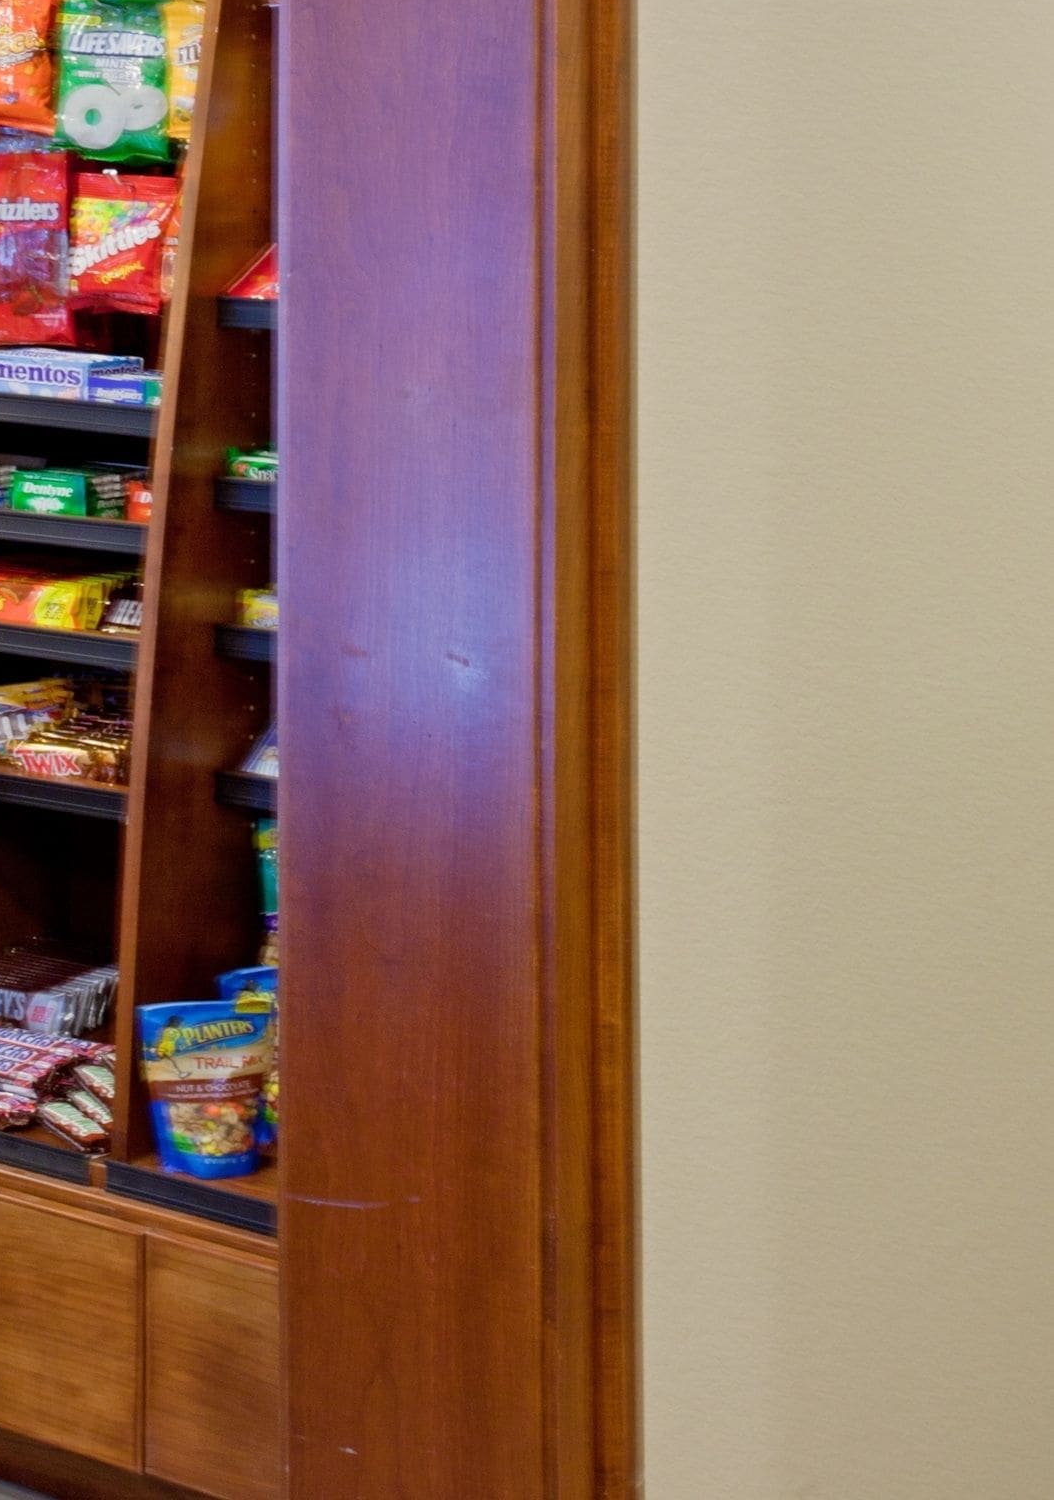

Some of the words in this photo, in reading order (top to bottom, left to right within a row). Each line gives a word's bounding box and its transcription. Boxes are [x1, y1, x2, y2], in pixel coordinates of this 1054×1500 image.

[67, 220, 161, 276] Skittles
[21, 481, 74, 498] Dentyne
[14, 747, 81, 776] TWIX
[182, 1020, 254, 1046] PLANTERS
[194, 1056, 239, 1070] TRAIL
[176, 1084, 195, 1093] NUT
